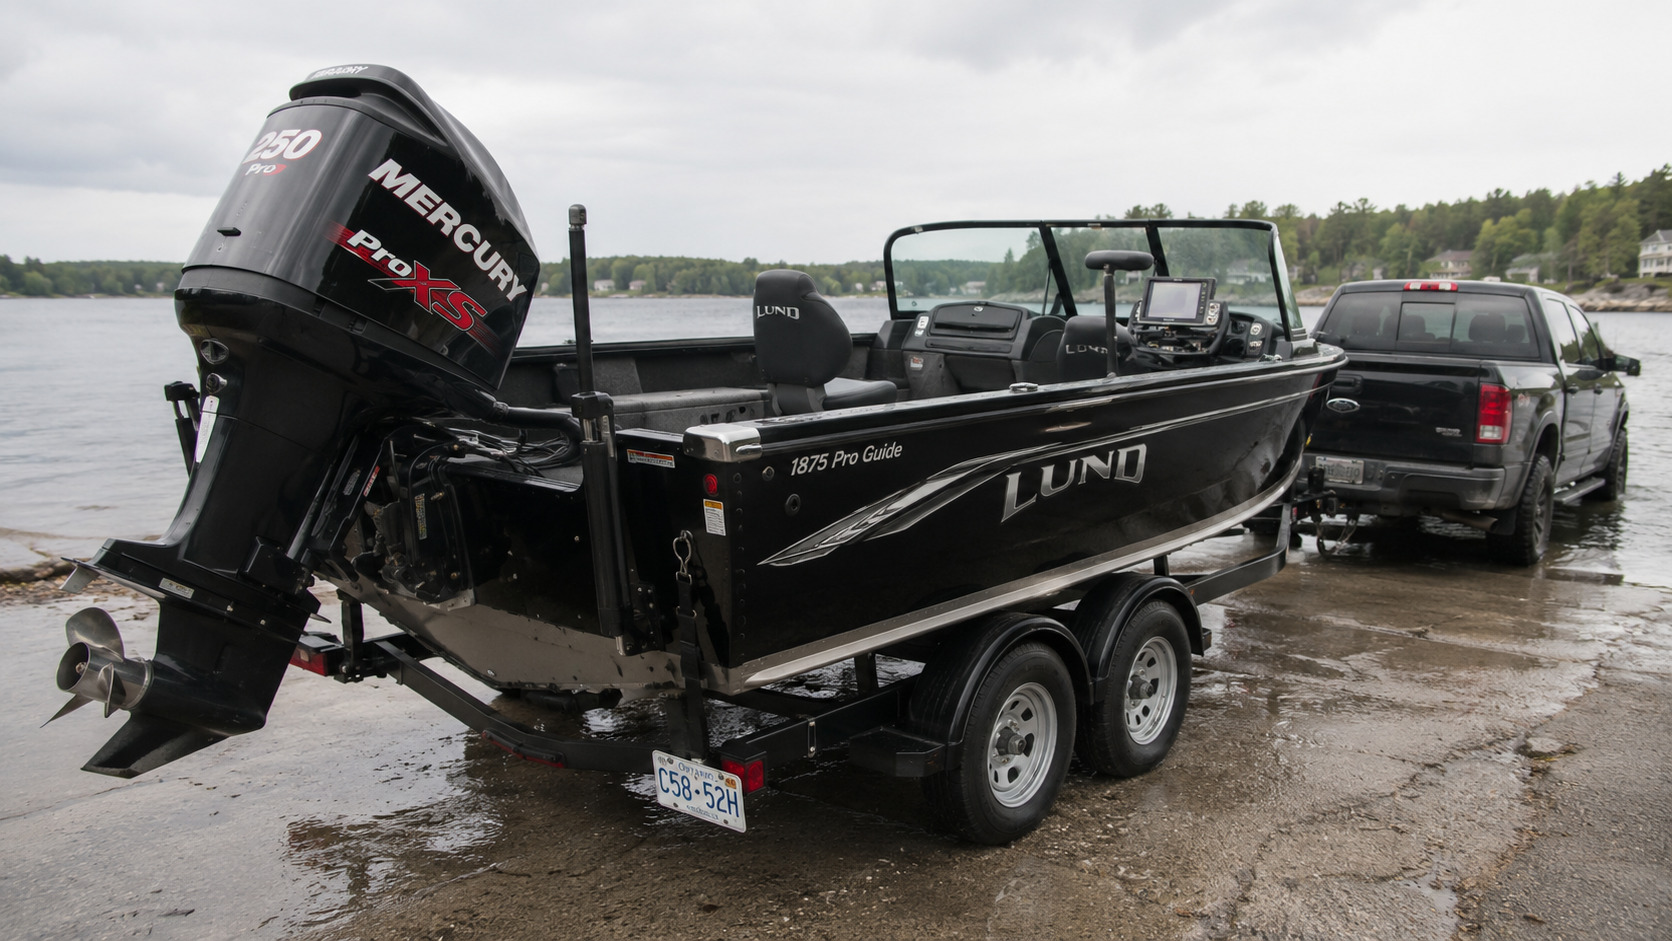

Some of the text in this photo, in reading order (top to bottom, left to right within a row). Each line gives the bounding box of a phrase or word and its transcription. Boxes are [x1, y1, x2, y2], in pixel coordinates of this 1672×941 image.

[242, 129, 323, 164] 250
[368, 158, 528, 301] MERCURY
[756, 305, 800, 320] LUND
[791, 441, 903, 476] 1875 Pro Guide
[1001, 443, 1148, 523] LUND
